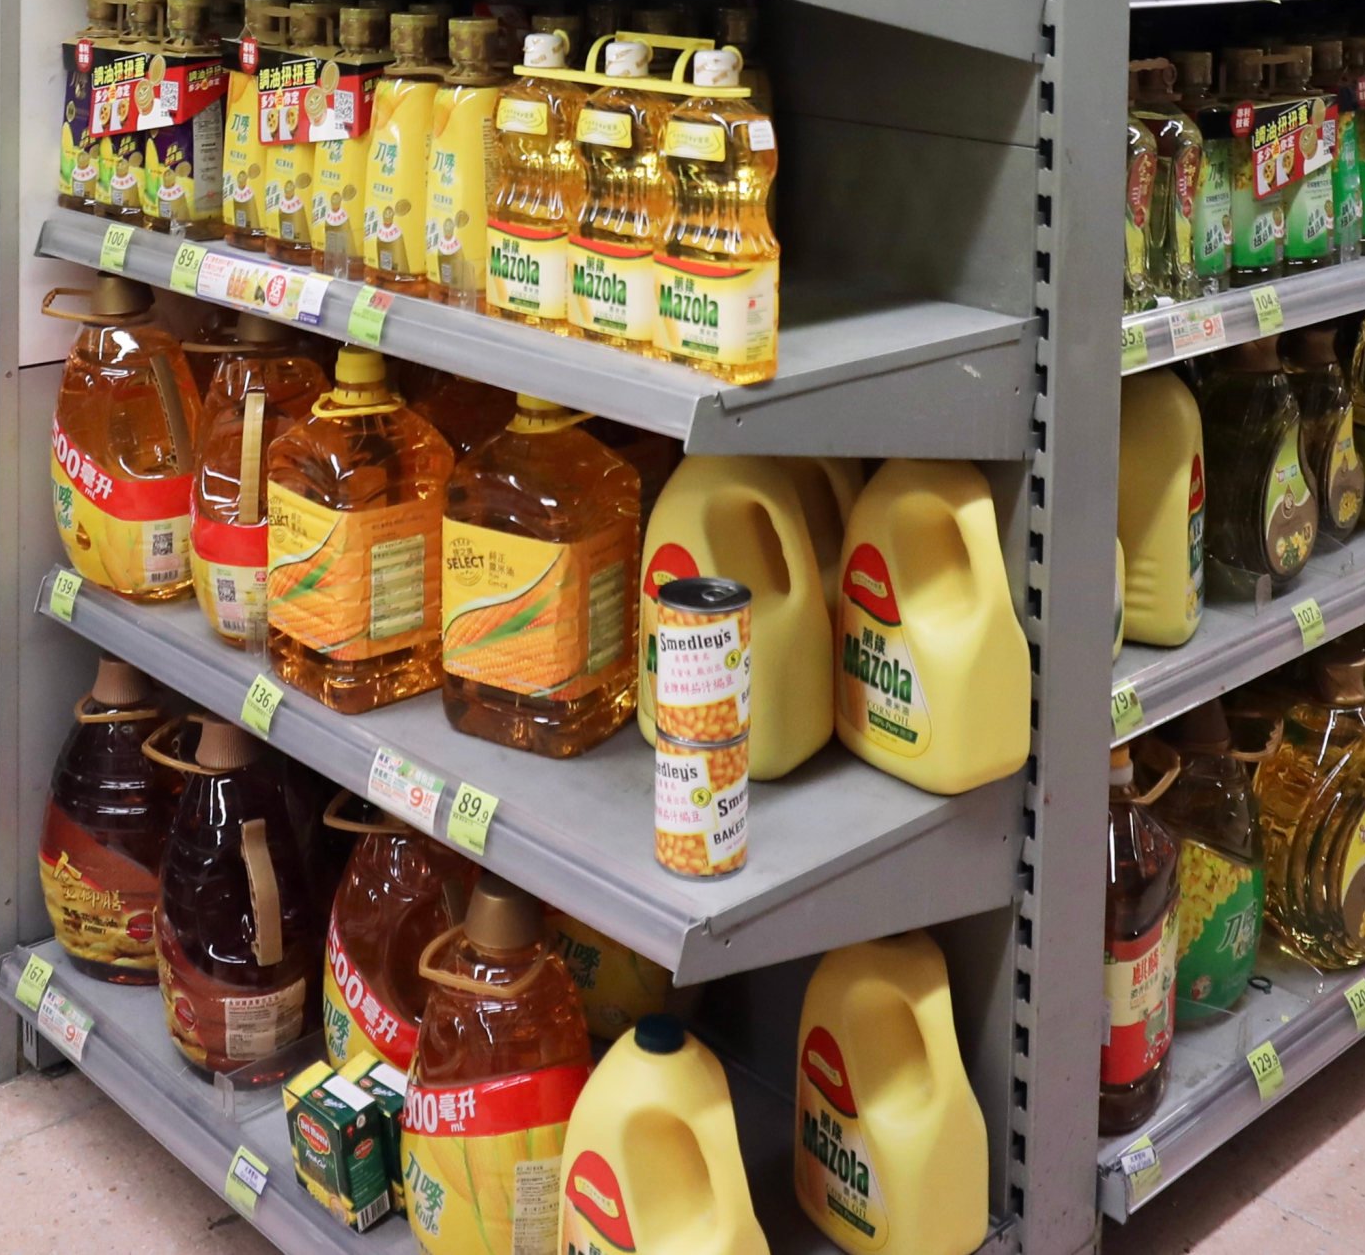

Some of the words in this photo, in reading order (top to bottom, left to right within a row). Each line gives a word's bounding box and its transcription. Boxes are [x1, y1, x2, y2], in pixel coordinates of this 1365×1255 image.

[92, 56, 146, 89] 調油扭扭蓋
[258, 58, 317, 91] 調油扭扭蓋
[1254, 103, 1309, 148] 調油扭扭蓋
[490, 245, 540, 287] Mazola
[572, 264, 627, 308] Mazola
[658, 283, 719, 328] Mazola
[446, 553, 486, 571] SELECT
[660, 630, 733, 653] Smedley's
[842, 647, 914, 706] Mazola
[251, 681, 276, 715] 136.0
[457, 791, 491, 825] 89.9
[713, 816, 747, 846] BAKED
[1251, 1053, 1280, 1076] 129.9
[300, 1118, 311, 1133] Del
[311, 1125, 329, 1149] Monte
[450, 1118, 467, 1133] mL
[803, 1120, 871, 1199] Mazola
[405, 1150, 447, 1221] 刀嘜
[415, 1199, 440, 1237] Knife
